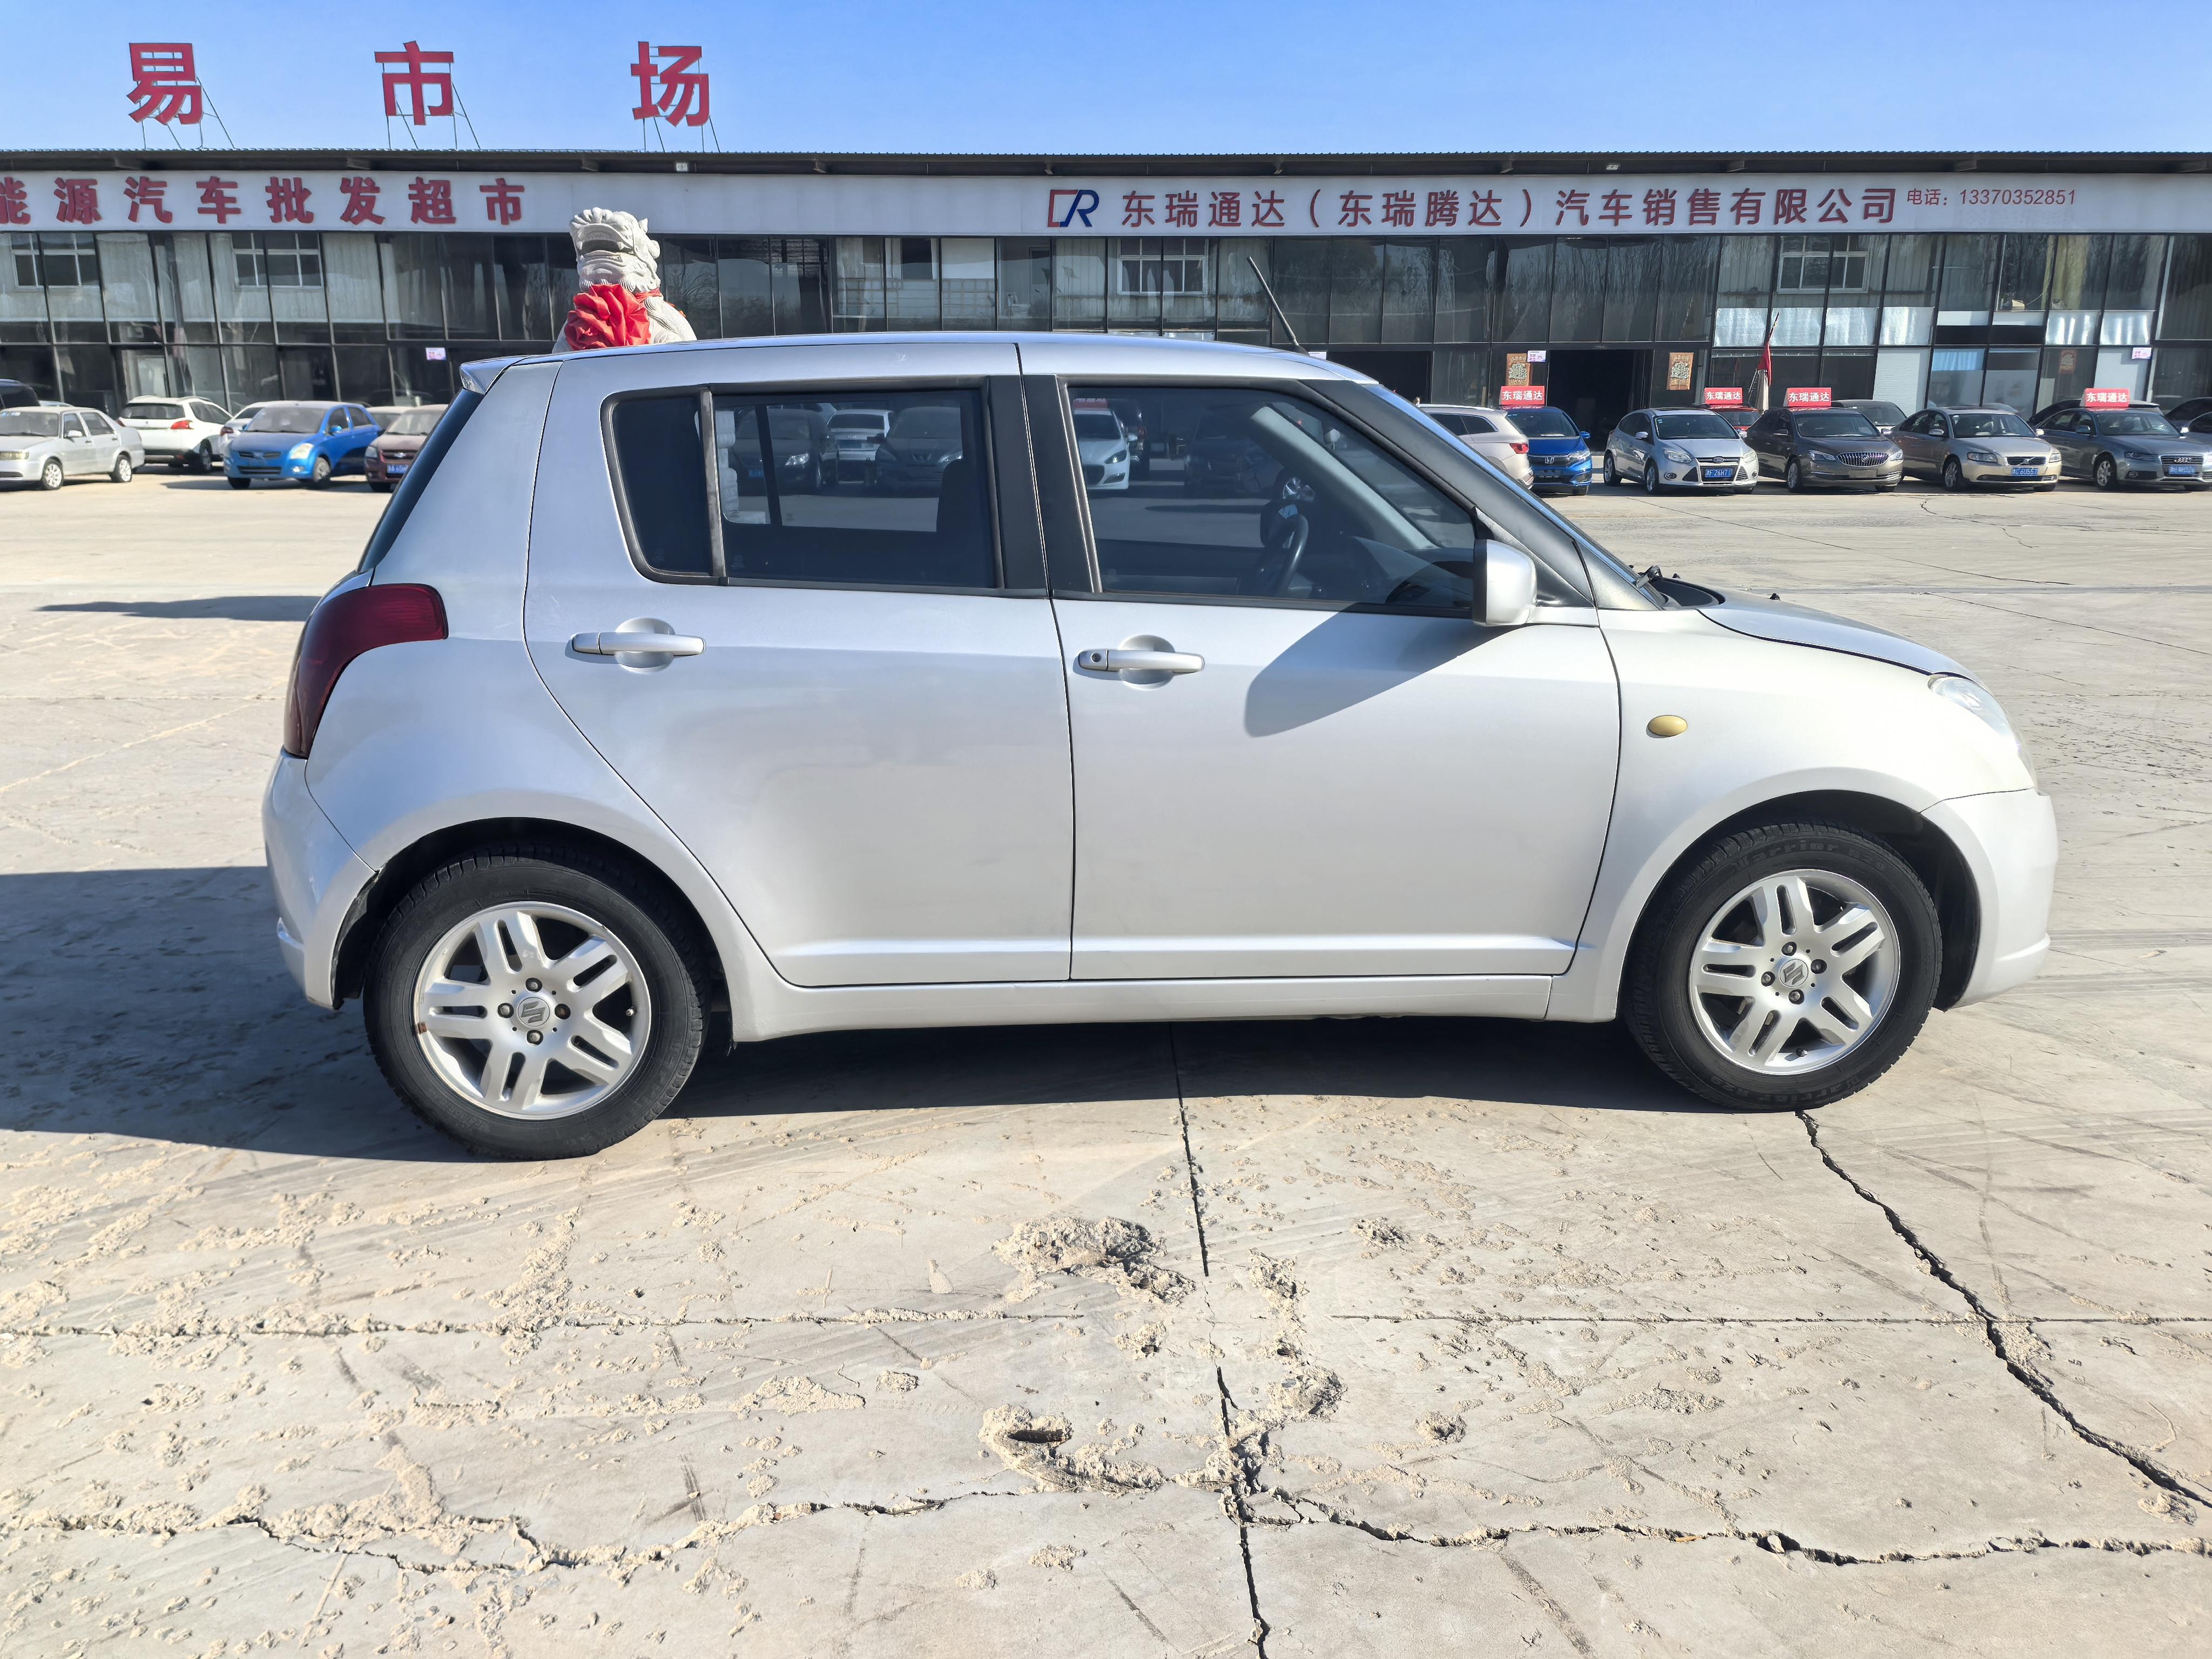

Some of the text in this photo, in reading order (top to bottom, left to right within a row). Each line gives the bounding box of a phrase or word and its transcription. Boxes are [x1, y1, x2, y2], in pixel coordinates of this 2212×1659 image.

[1502, 390, 1544, 401] 东瑞通达
[1705, 391, 1742, 401] 东瑞通达
[1789, 392, 1831, 402] 东瑞通达
[2086, 392, 2128, 403] 东瑞通达
